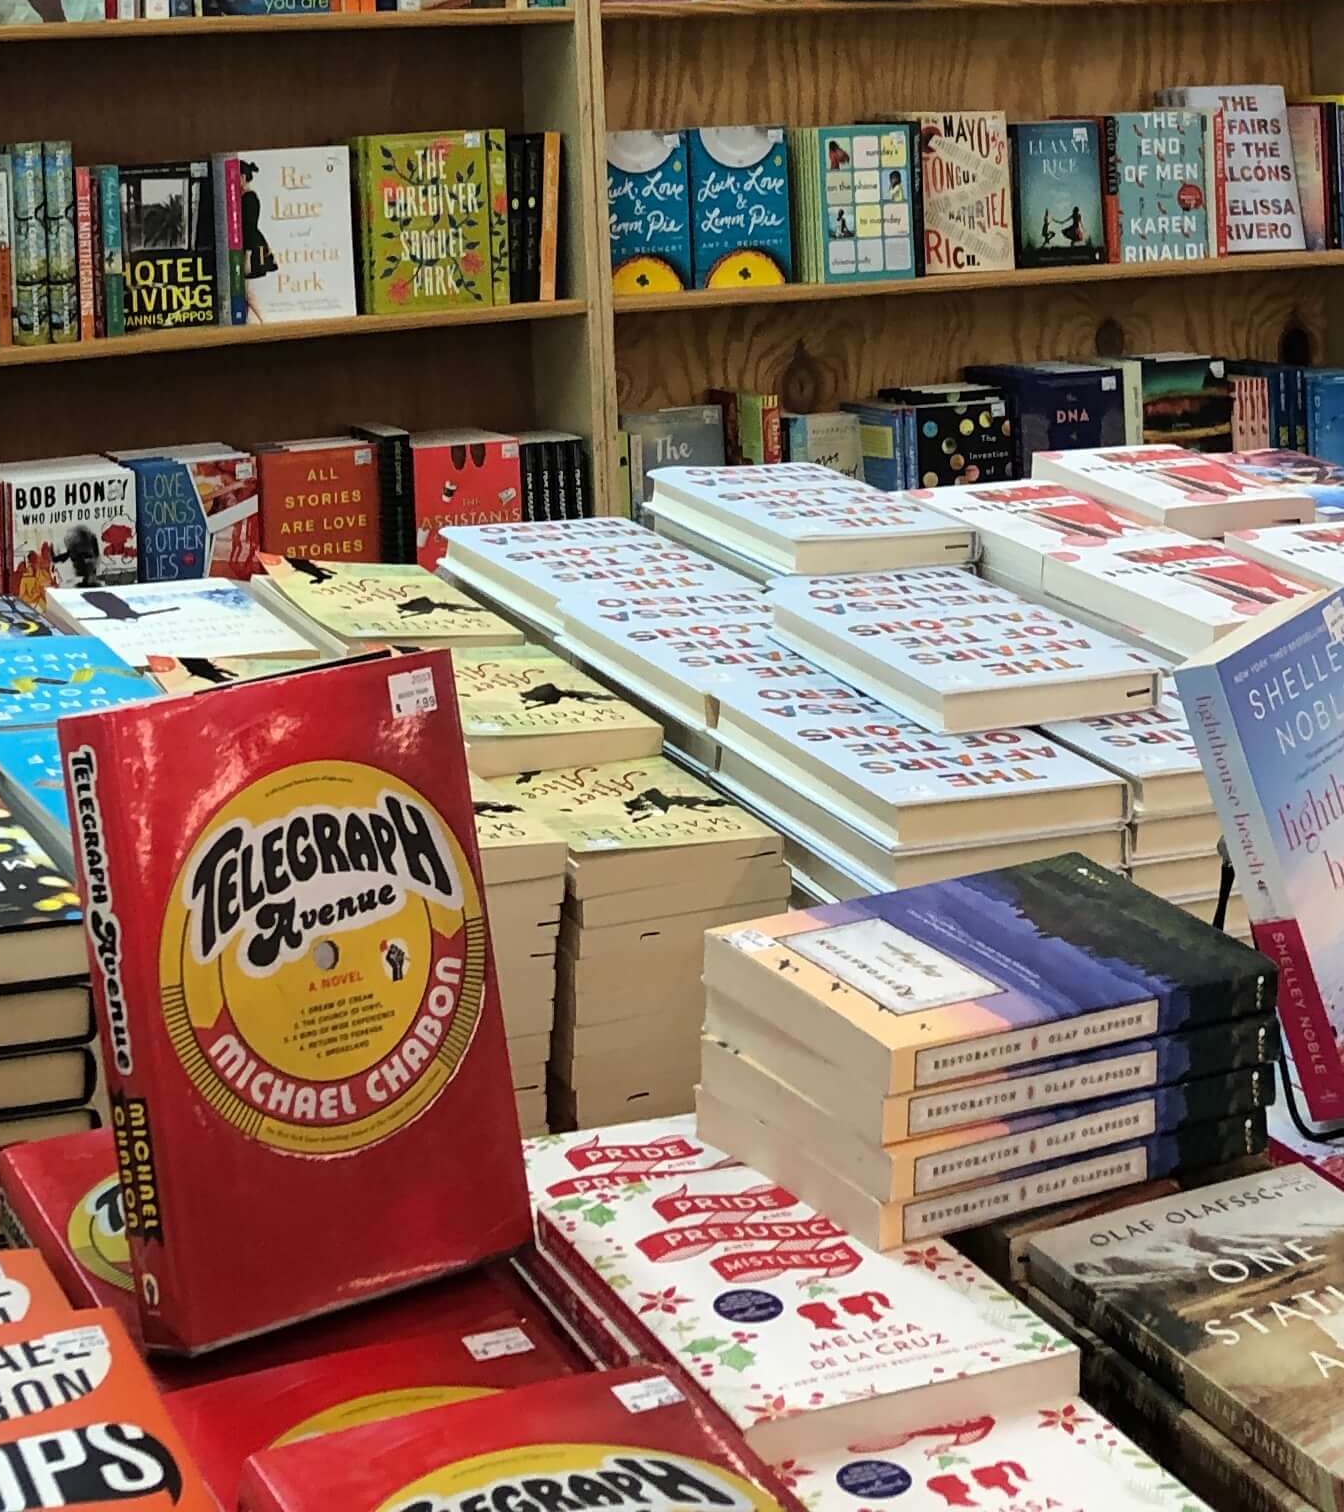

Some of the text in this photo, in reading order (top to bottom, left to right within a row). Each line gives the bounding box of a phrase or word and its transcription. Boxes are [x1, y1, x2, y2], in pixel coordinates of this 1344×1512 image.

[1142, 138, 1179, 156] END
[415, 149, 447, 180] THE
[1124, 161, 1199, 183] OF MEN
[743, 166, 784, 194] Love
[271, 196, 323, 220] Jane
[383, 183, 480, 218] CAREGIVER
[1130, 215, 1196, 234] KAREN
[401, 227, 467, 263] SAMUEL
[1125, 244, 1204, 261] RINALDI
[277, 273, 323, 294] Park
[413, 265, 458, 297] PARK
[1057, 410, 1089, 423] DNA
[143, 471, 185, 499] LOVE
[307, 468, 339, 481] ALL
[285, 490, 361, 507] STORIES
[144, 498, 196, 527] SONGS
[280, 513, 367, 535] ARE LOVE
[156, 527, 203, 556] OTHER
[287, 541, 363, 558] STORIES
[145, 554, 179, 580] LIES
[191, 794, 454, 957] TELEGRAPH
[248, 885, 397, 968] Avenue
[309, 971, 363, 991] A NOVEL
[208, 1032, 356, 1120] MICHAEL
[365, 955, 461, 1103] CHABON
[672, 1193, 780, 1213] PRIDE
[723, 1251, 850, 1276] MISTLETOE
[1207, 1238, 1327, 1284] ONE
[809, 1322, 923, 1352] MELISSA
[809, 1333, 950, 1369] DE LA CRUZ
